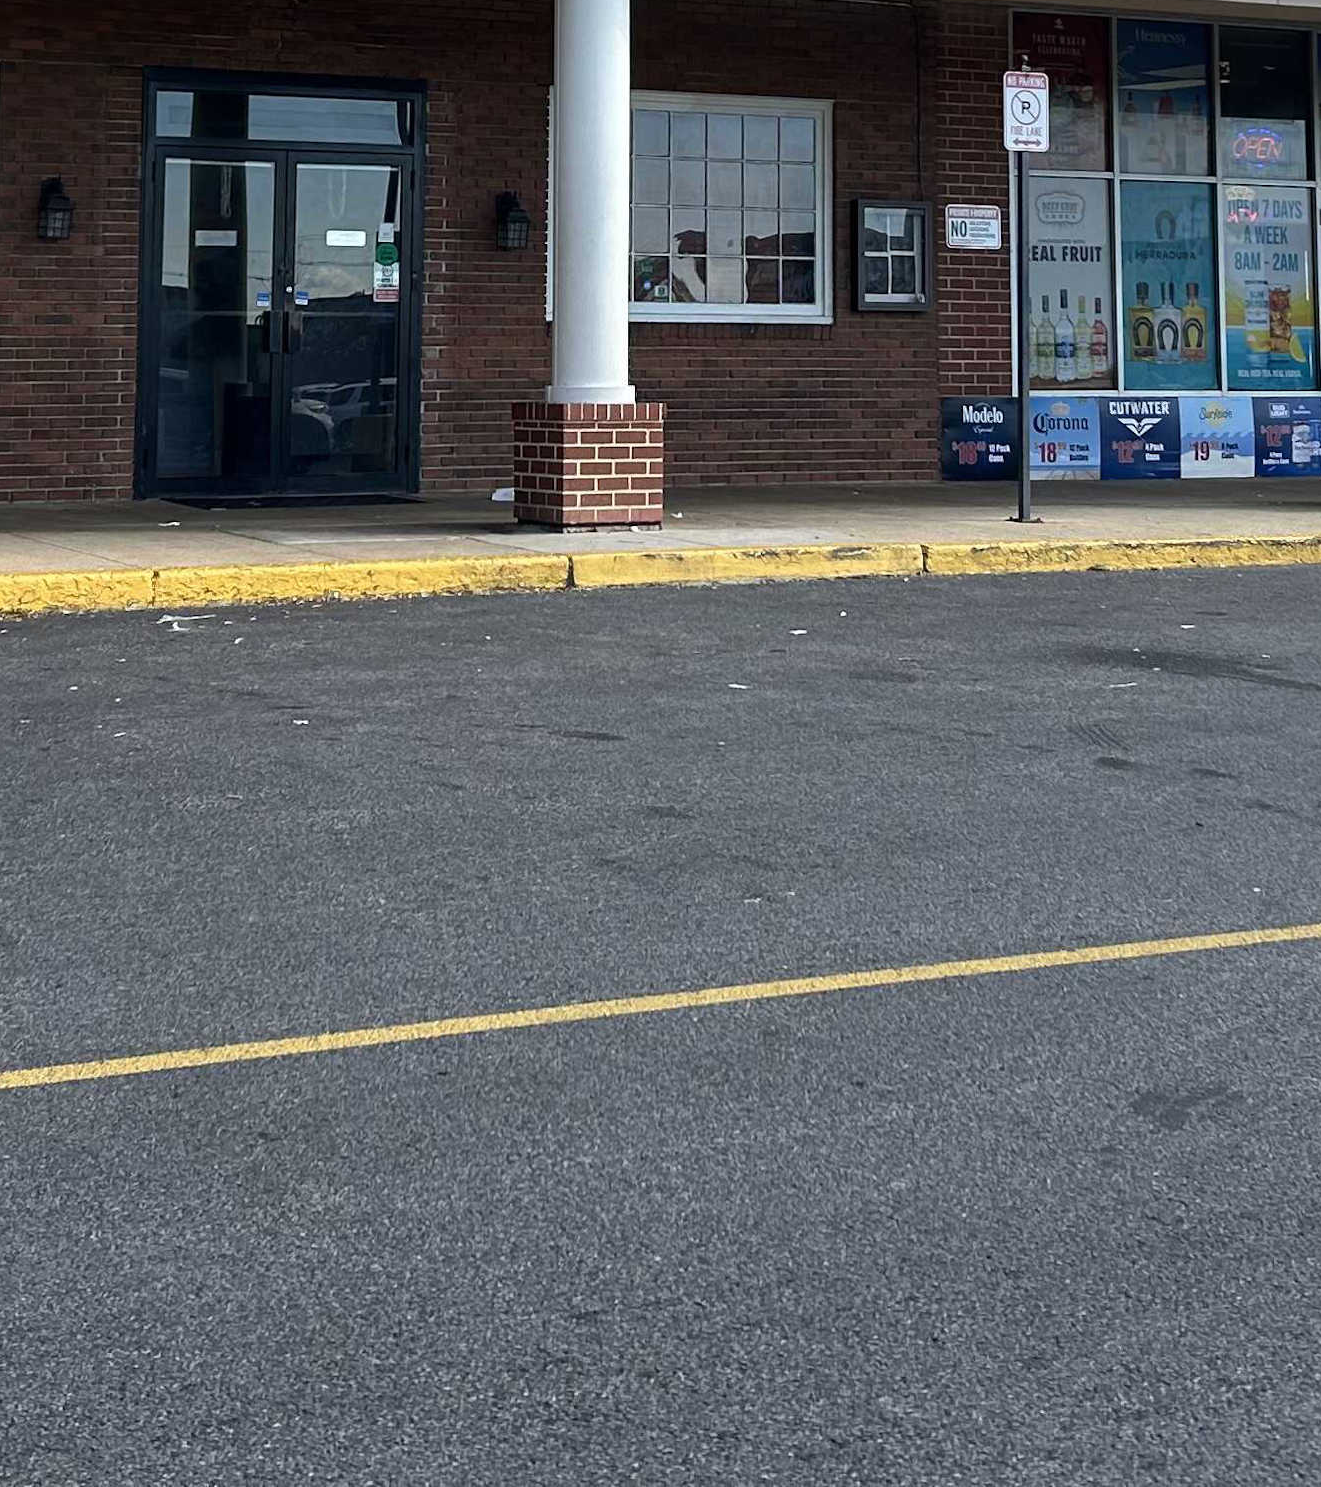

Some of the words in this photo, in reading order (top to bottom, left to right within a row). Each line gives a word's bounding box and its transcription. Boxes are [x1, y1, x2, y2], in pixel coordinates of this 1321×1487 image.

[1231, 135, 1285, 159] OPEN
[1262, 200, 1270, 217] 7
[1273, 200, 1303, 219] DAYS
[951, 219, 967, 238] NO
[1243, 225, 1253, 244] A
[1254, 226, 1289, 245] WEEK
[1061, 245, 1103, 263] FRUIT
[1234, 251, 1261, 271] 8AM
[1272, 252, 1299, 272] 2AM
[962, 404, 1004, 424] Modelo
[1109, 400, 1170, 415] CUTWATER
[1033, 412, 1089, 436] Corona
